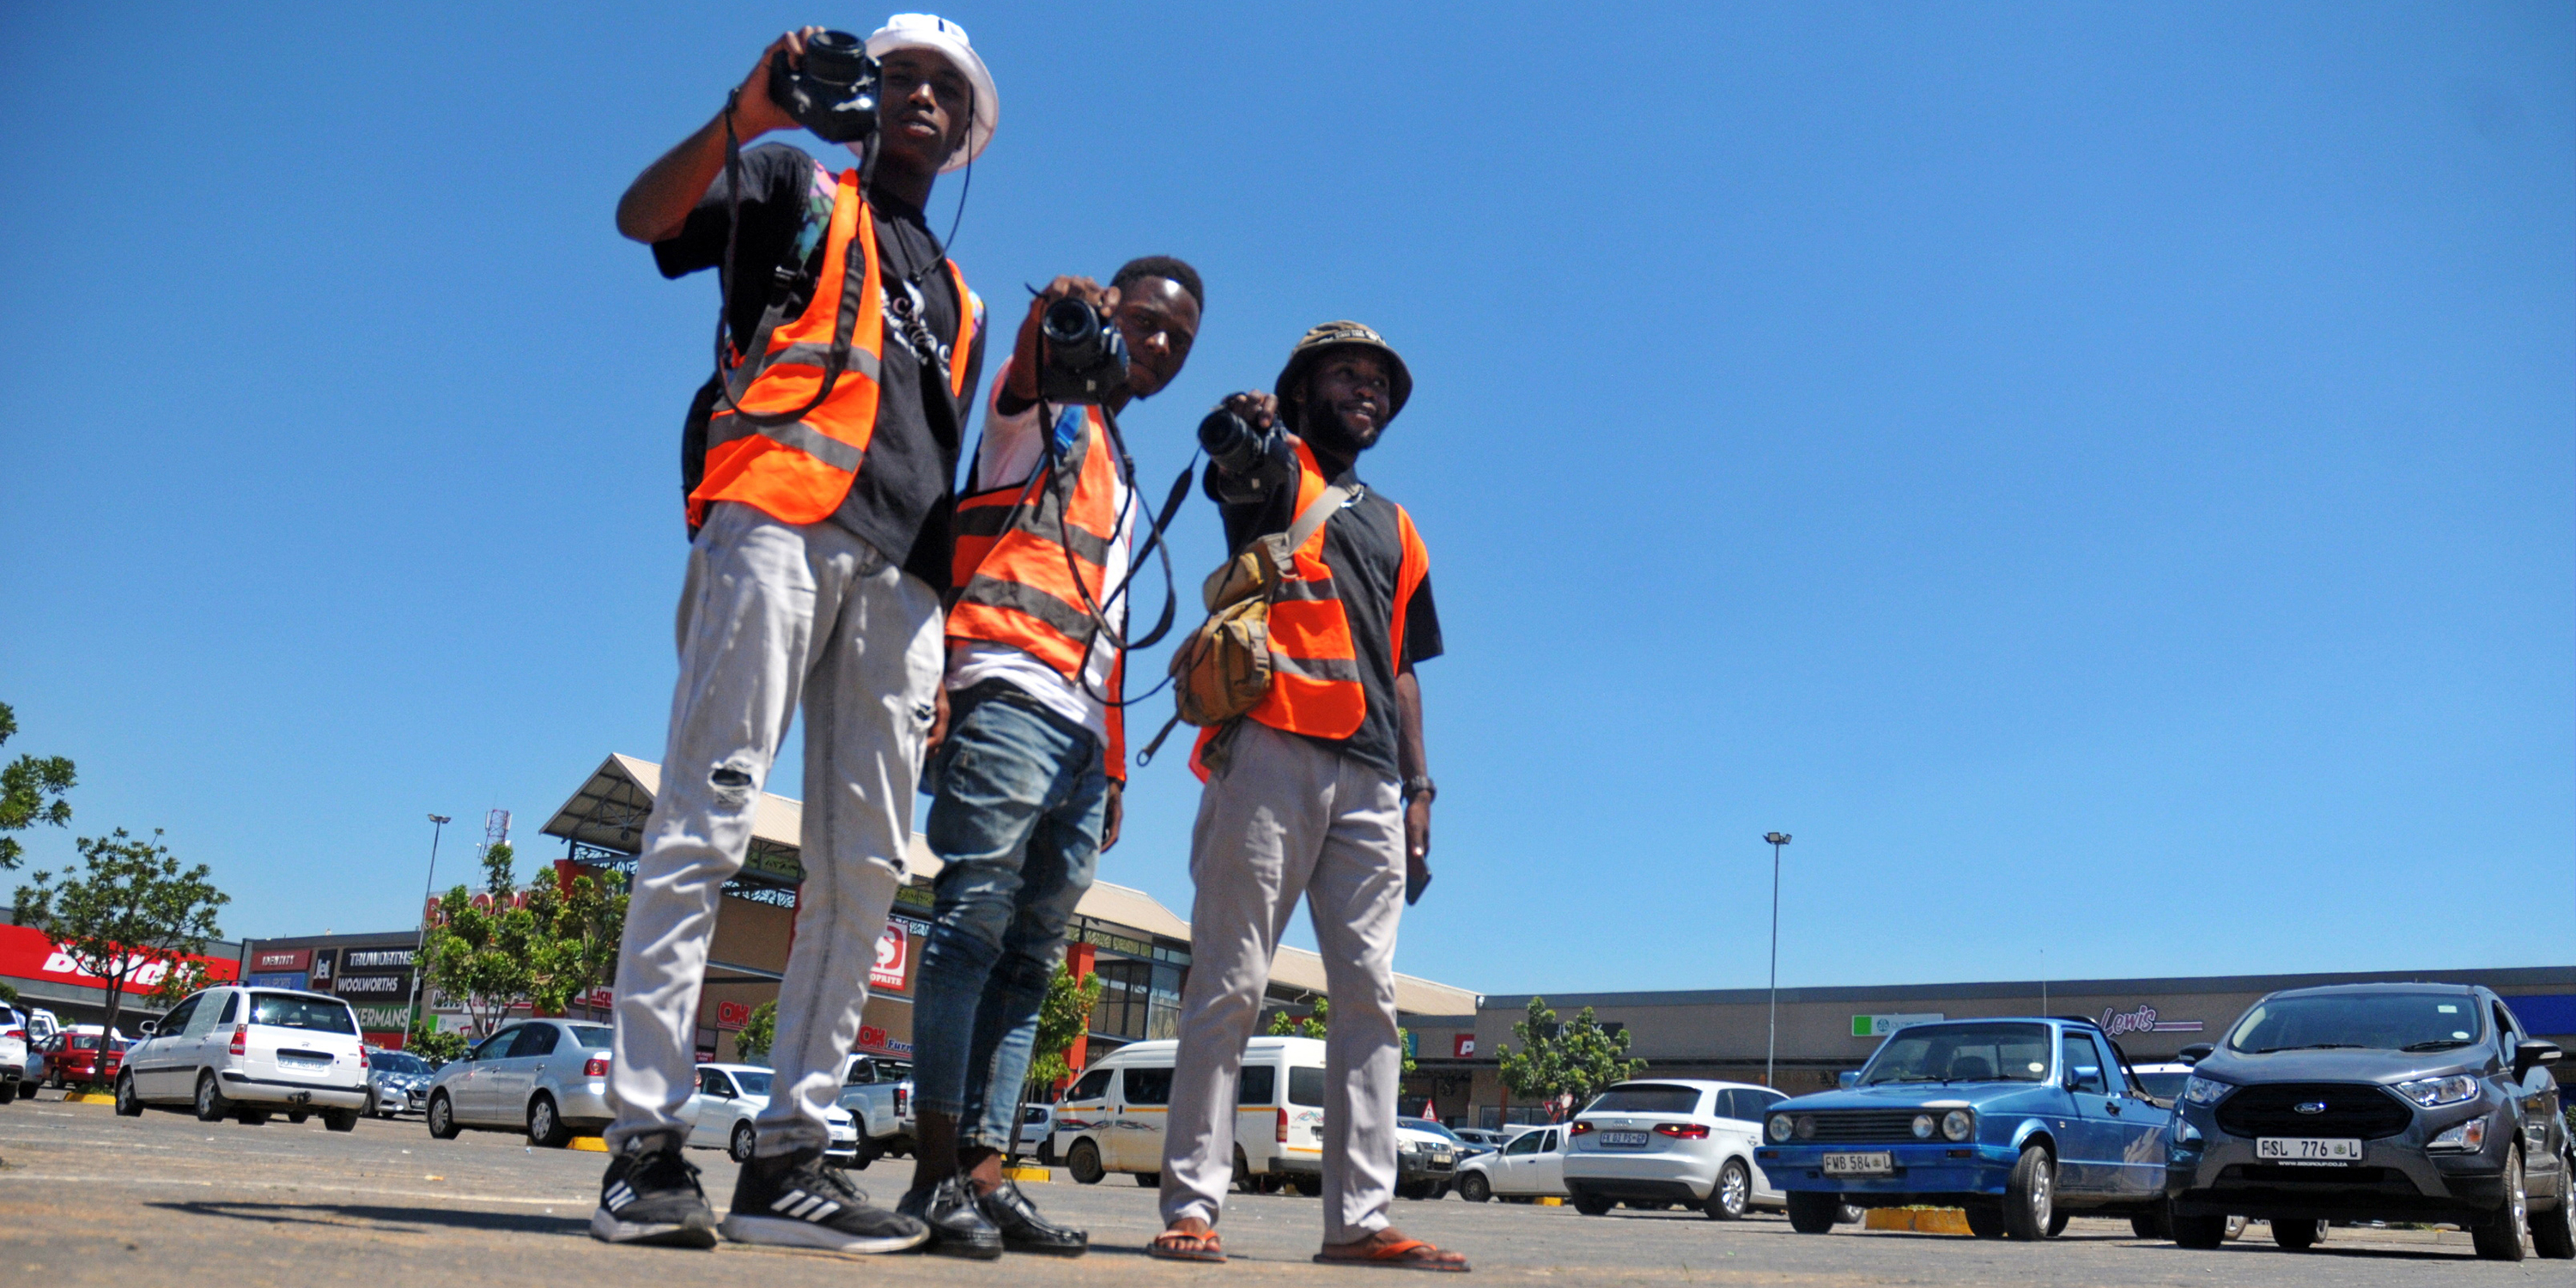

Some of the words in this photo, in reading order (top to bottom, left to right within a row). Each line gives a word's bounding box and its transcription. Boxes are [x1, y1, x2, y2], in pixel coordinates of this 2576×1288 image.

[262, 954, 295, 965] IDENTITY
[349, 950, 413, 967] TRUWORTHS
[313, 959, 330, 979] Jet
[337, 976, 398, 993] WOOLWORTHS
[718, 1001, 750, 1026] OK
[2100, 1005, 2156, 1037] Lewis
[859, 1025, 886, 1048] OK
[2262, 1140, 2288, 1157] FSL
[2301, 1141, 2328, 1157] 776
[2349, 1141, 2358, 1157] L
[1826, 1156, 1847, 1170] FWB
[1850, 1156, 1871, 1170] 584
[1884, 1155, 1891, 1169] L
